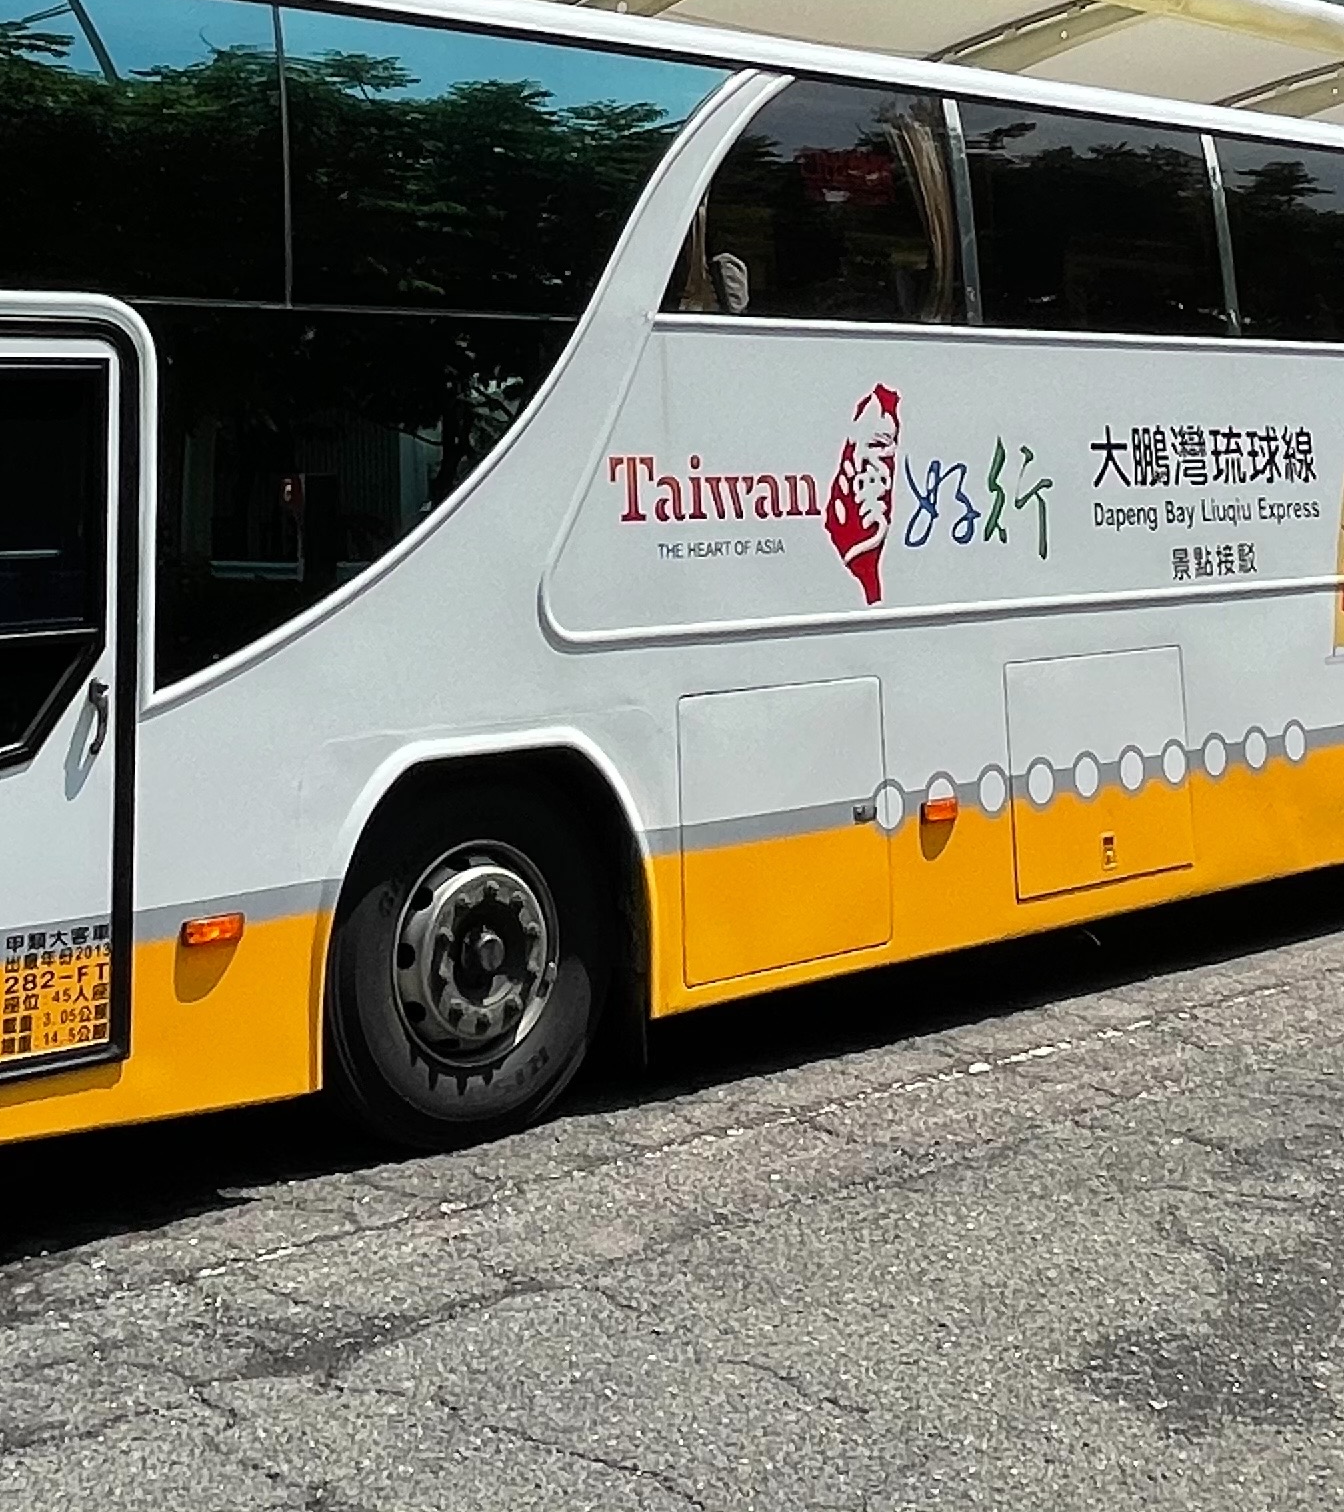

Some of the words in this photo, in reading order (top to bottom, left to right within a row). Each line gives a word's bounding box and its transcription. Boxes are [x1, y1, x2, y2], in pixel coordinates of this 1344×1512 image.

[1090, 425, 1317, 488] 大鵬灣琉球線
[608, 454, 823, 524] Taiwan
[1094, 502, 1158, 532] Dapeng
[1164, 499, 1195, 529] Bay
[1202, 498, 1252, 527] Liuqiu
[1258, 496, 1320, 525] Express
[658, 542, 684, 560] THE
[688, 541, 732, 558] HEART
[734, 540, 752, 556] OF
[755, 538, 786, 555] ASIA
[1172, 543, 1258, 581] 景點接駁
[4, 962, 110, 995] 282-FT
